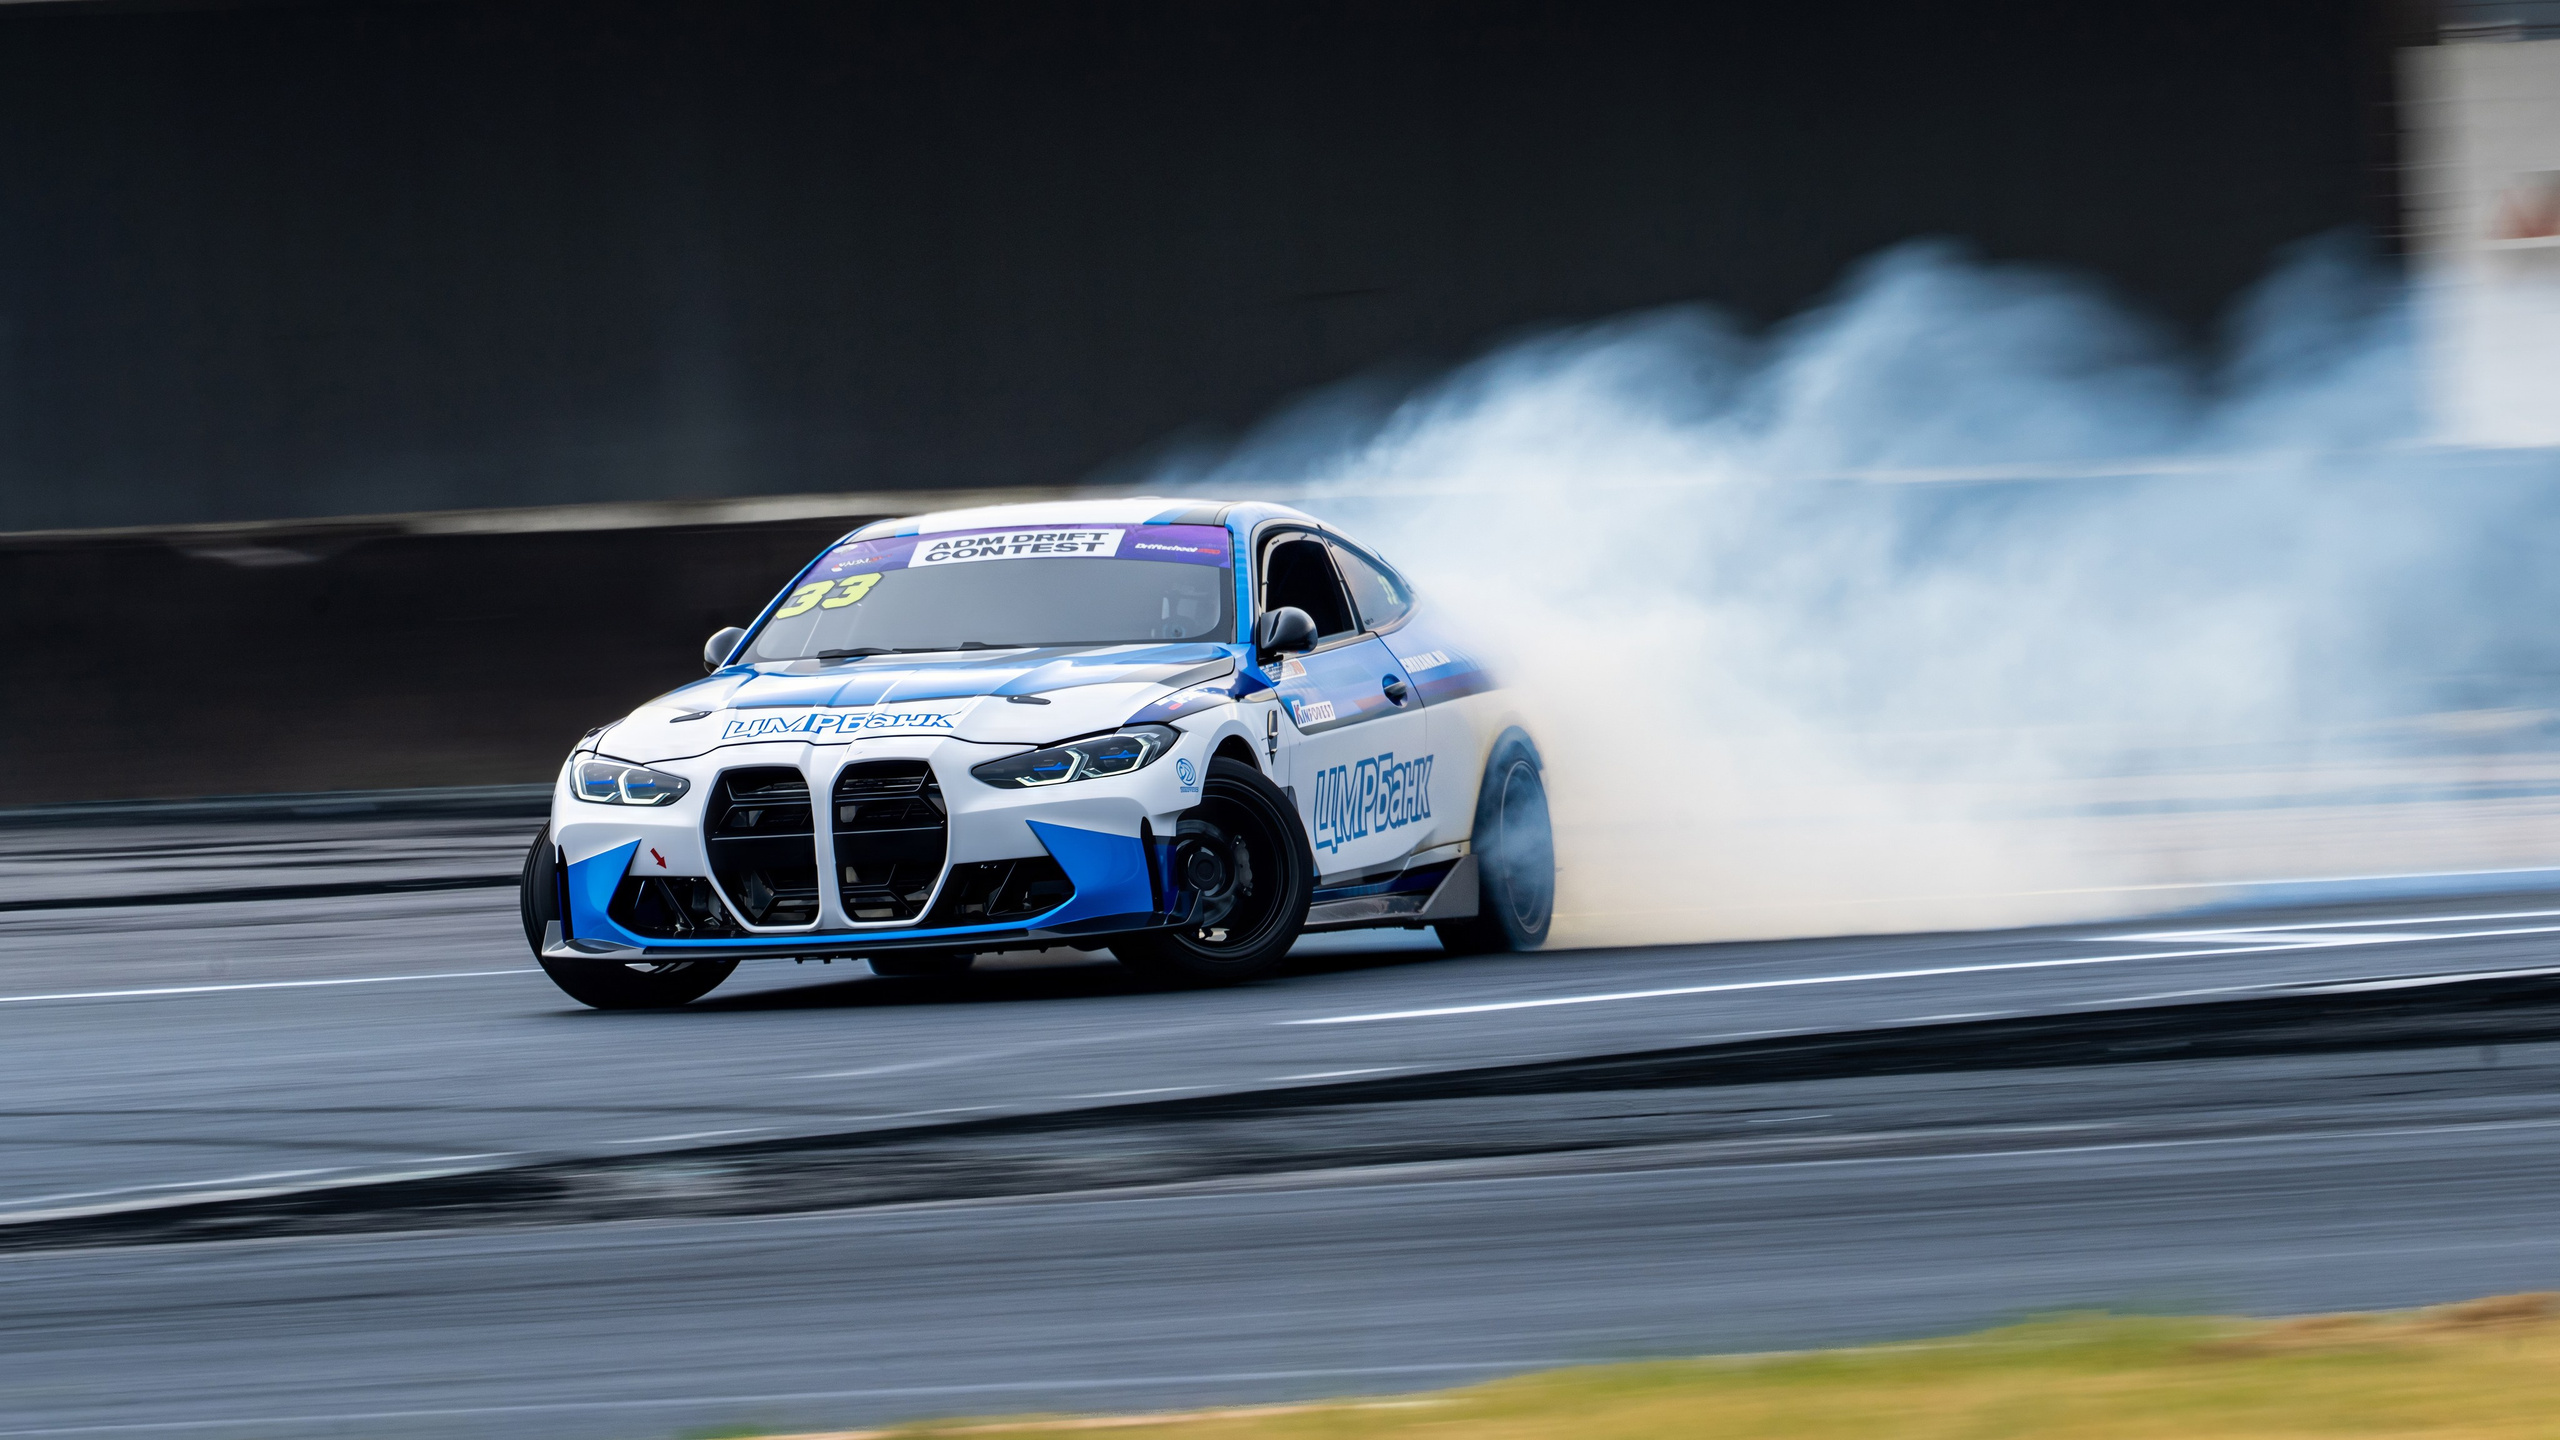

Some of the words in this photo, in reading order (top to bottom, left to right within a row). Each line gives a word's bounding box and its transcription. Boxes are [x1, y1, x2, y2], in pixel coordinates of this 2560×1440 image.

[925, 542, 1105, 562] CONTEST
[929, 536, 1006, 552] ADM
[1011, 532, 1110, 544] DRIFT
[774, 572, 884, 619] 33
